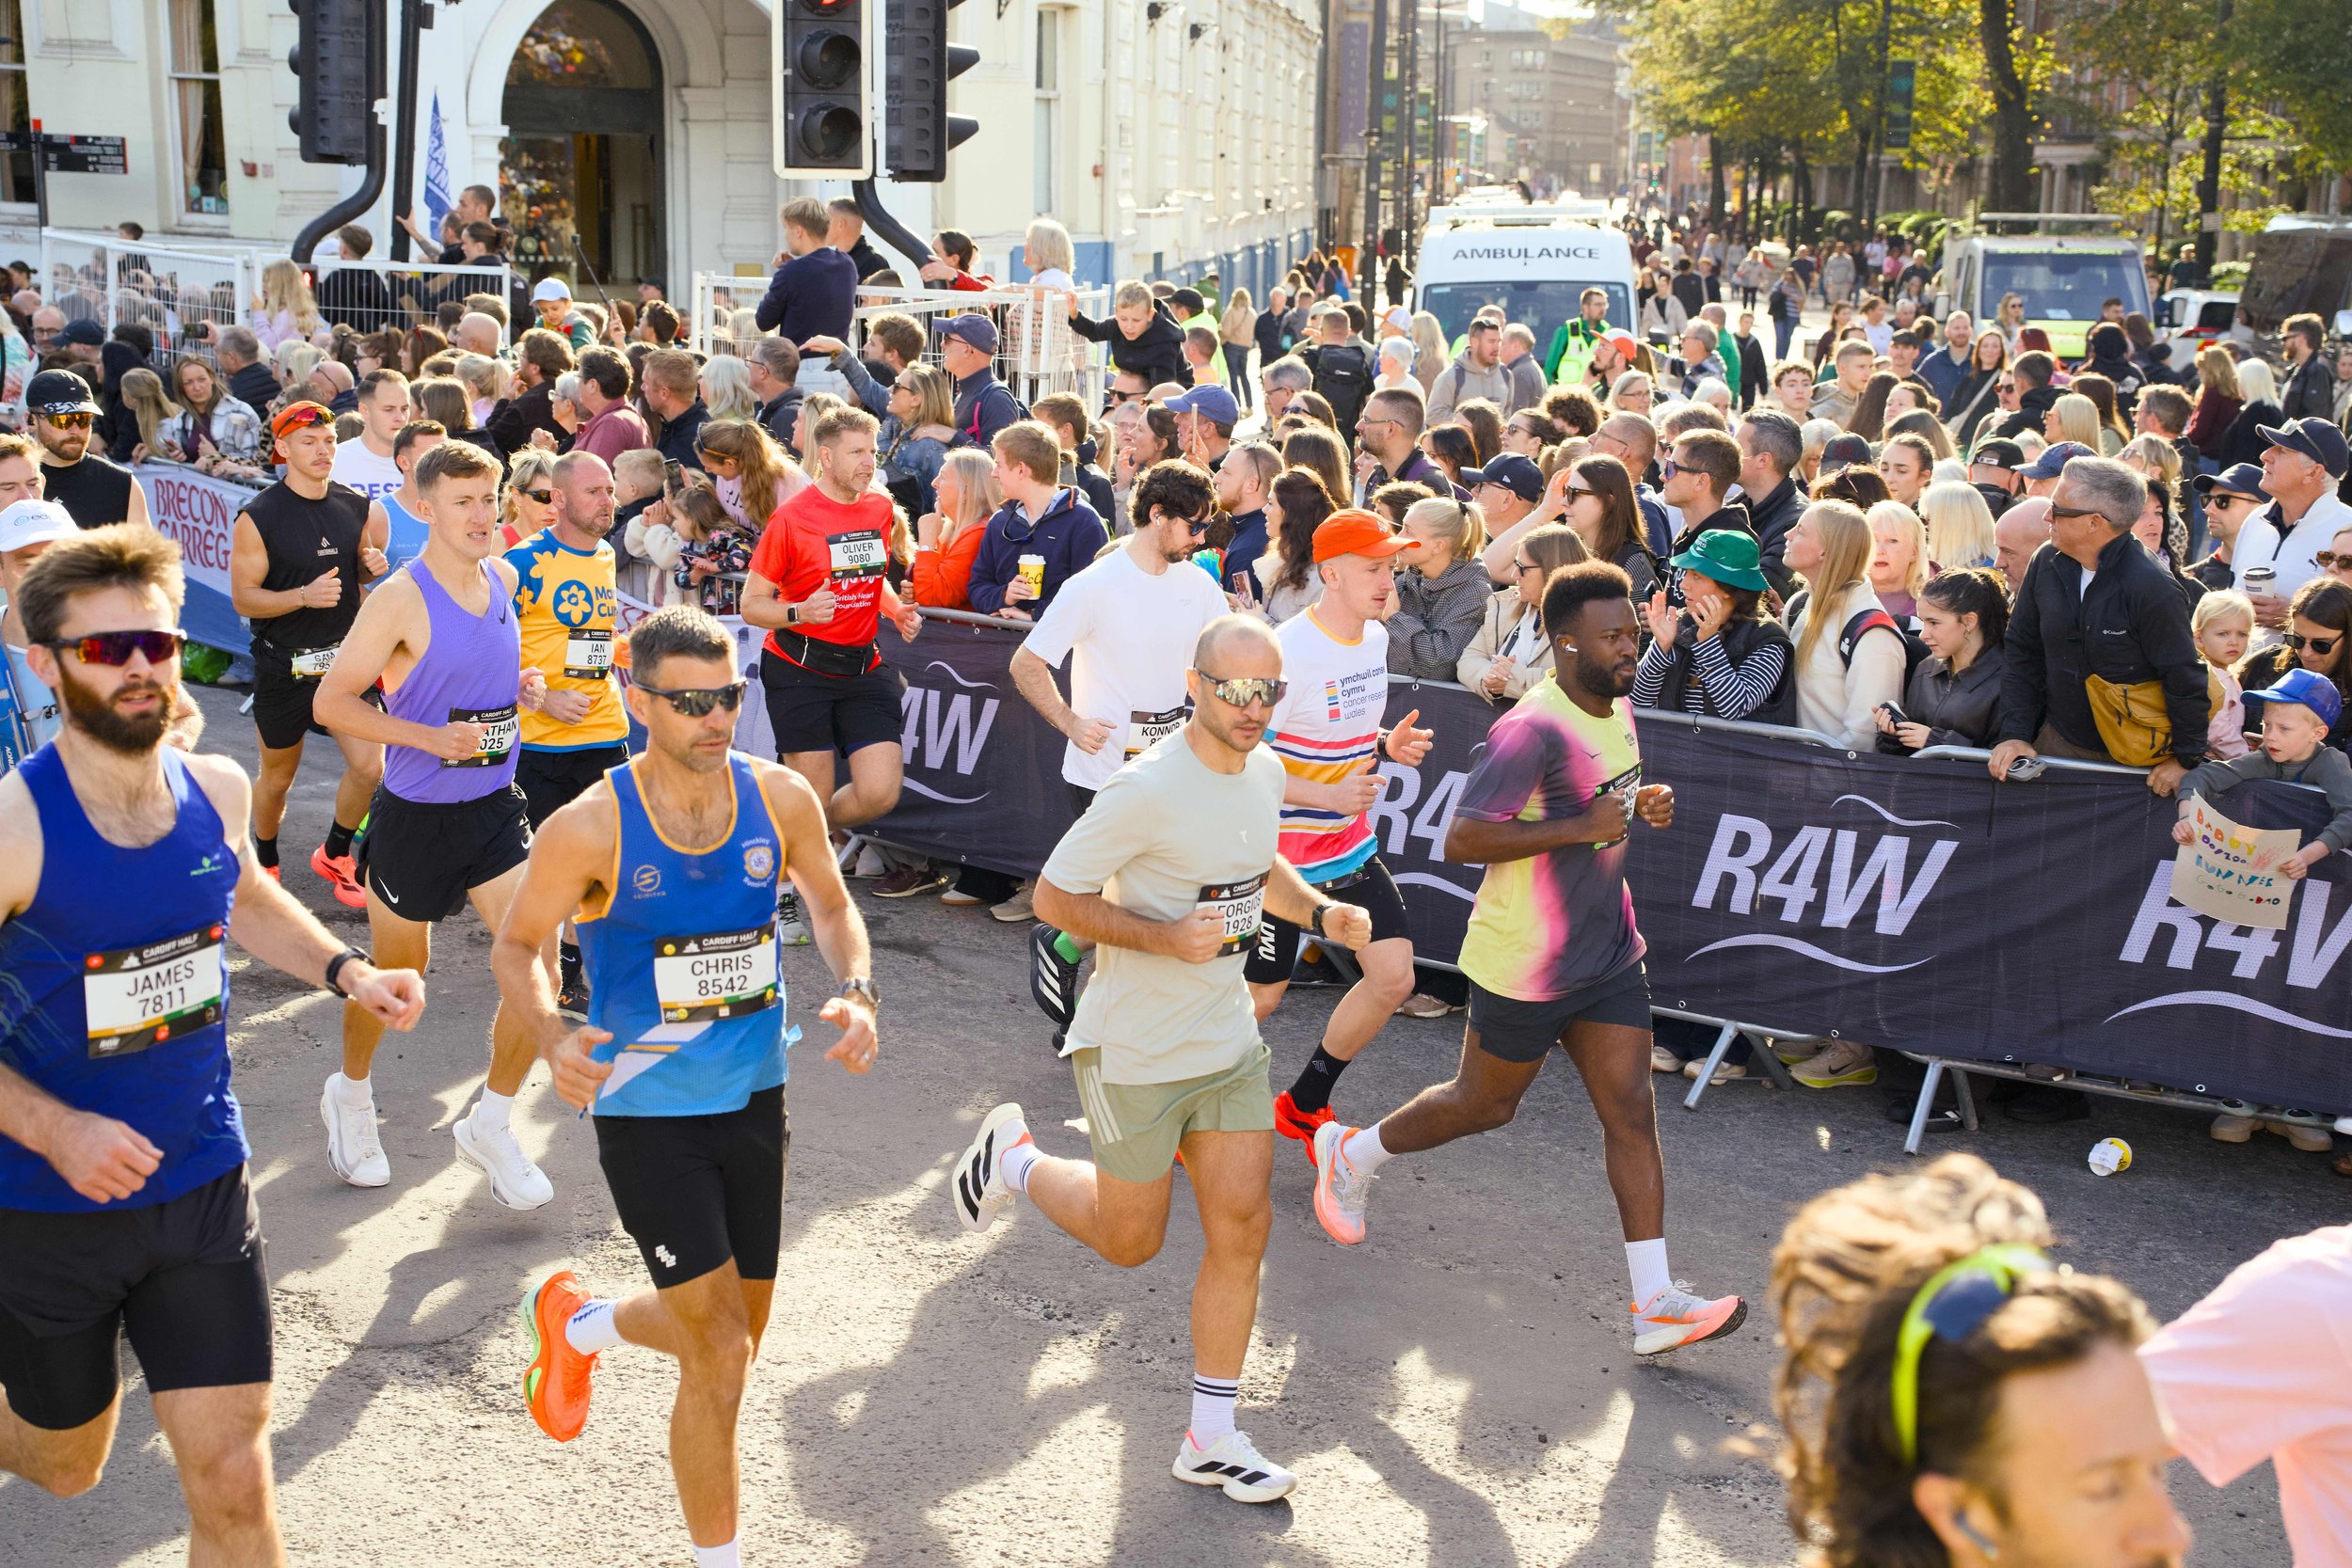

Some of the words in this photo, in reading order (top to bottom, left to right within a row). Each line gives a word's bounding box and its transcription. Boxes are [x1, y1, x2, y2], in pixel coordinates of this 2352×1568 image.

[1453, 247, 1600, 260] AMBULANCE
[154, 479, 228, 531] BRECON
[842, 543, 874, 554] OLIVER
[848, 553, 871, 564] 9080
[858, 592, 875, 600] Heart
[834, 601, 871, 610] Foundation
[592, 643, 605, 653] IAN
[314, 651, 336, 662] SAM
[587, 655, 607, 665] 8737
[1340, 669, 1373, 688] ymchwil
[1341, 685, 1366, 698] cymru
[1343, 695, 1368, 709] cancer
[1344, 707, 1366, 720] wales
[1692, 813, 1960, 936] R4W
[2196, 853, 2274, 887] RUNNER
[1232, 881, 1252, 893] CARDIFF
[1225, 915, 1253, 935] 1928
[702, 935, 739, 947] CARDIFF
[739, 929, 758, 942] HALF
[142, 940, 177, 959] CARDIFF
[177, 933, 199, 949] HALF
[691, 954, 753, 976] CHRIS
[127, 959, 195, 997] JAMES
[698, 974, 748, 996] 8542
[138, 987, 186, 1018] 7811
